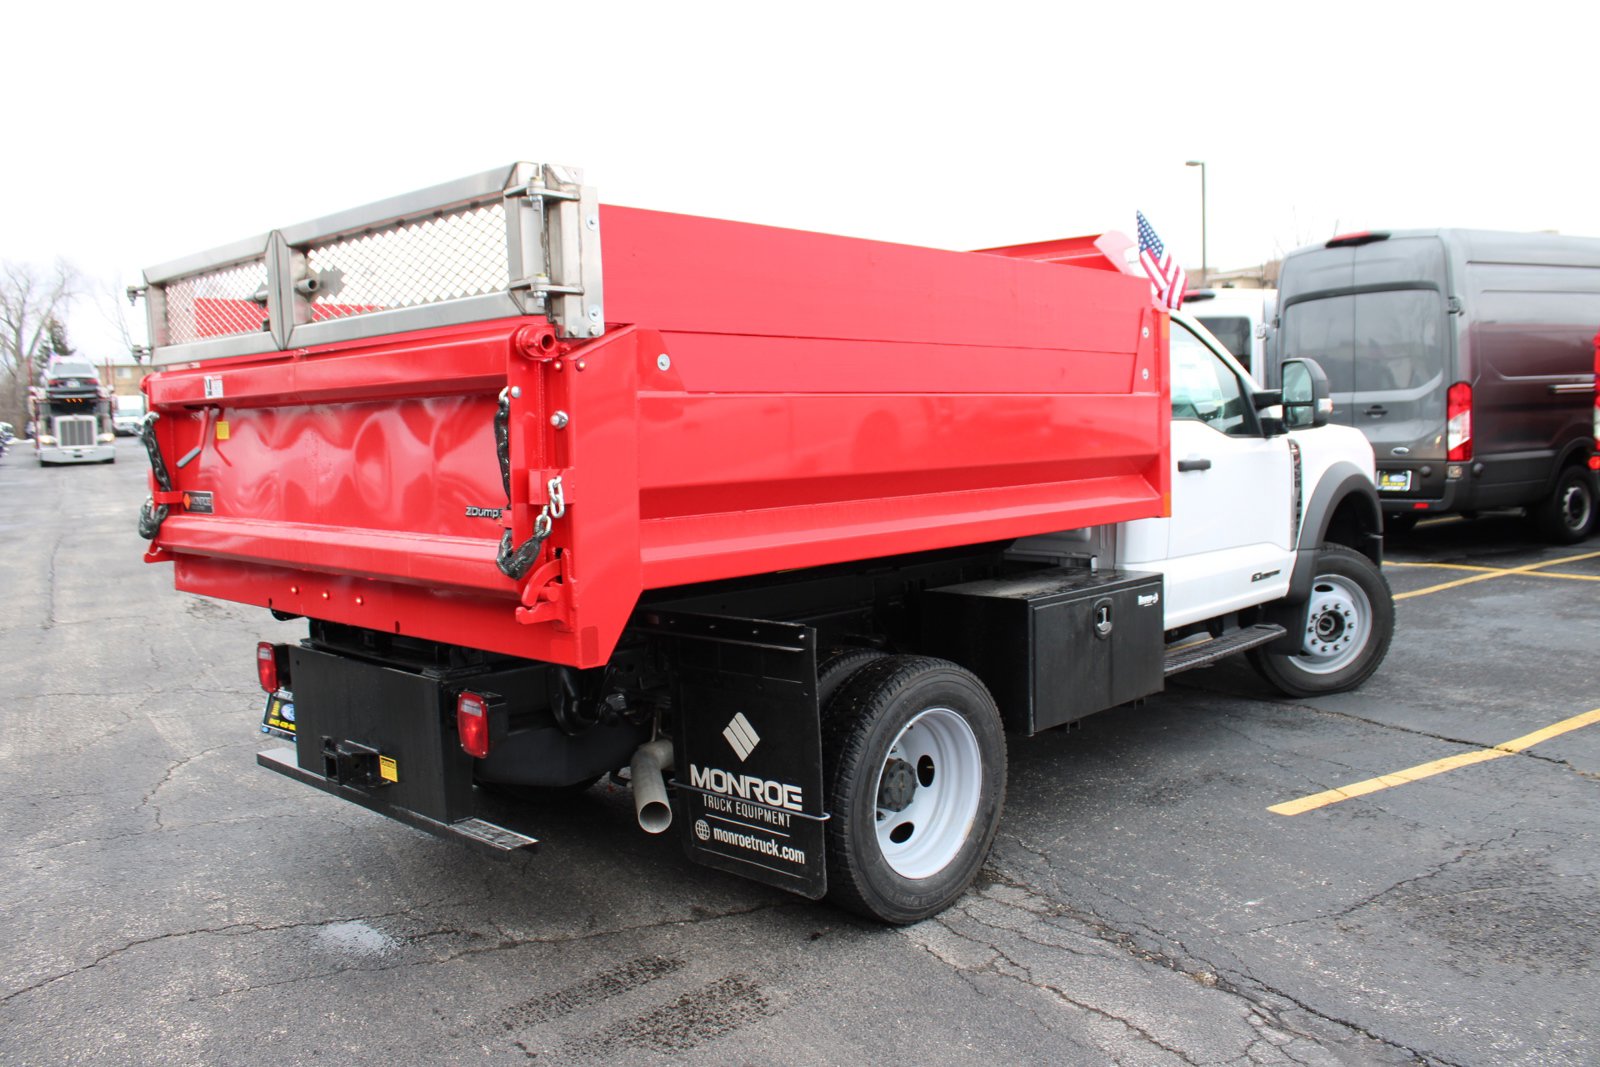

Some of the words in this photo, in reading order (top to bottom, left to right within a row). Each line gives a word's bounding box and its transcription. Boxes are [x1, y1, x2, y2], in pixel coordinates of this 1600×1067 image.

[690, 764, 803, 811] MONROE
[702, 793, 733, 814] TRUCK
[735, 801, 792, 828] EQUIPMENT
[713, 826, 806, 865] monroetruck.com
